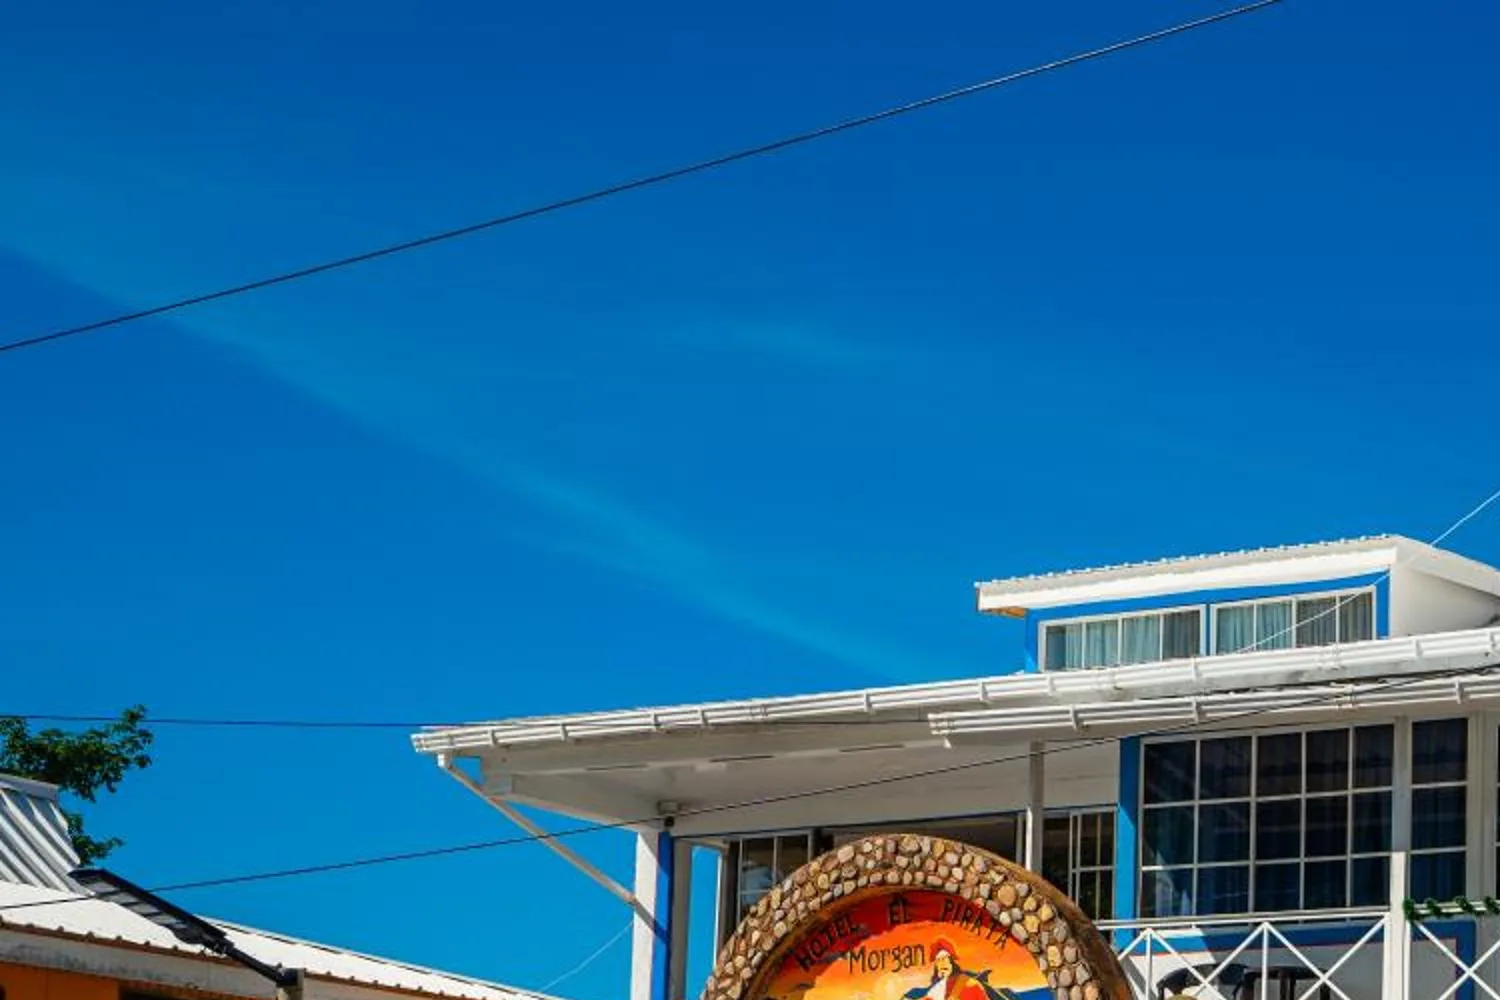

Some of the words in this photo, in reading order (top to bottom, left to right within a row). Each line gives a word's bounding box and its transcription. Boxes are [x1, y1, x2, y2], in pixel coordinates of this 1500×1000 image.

[795, 911, 858, 972] HOTEL
[888, 895, 911, 923] EL
[940, 898, 1008, 949] PIRATA
[849, 944, 925, 974] Morgan
